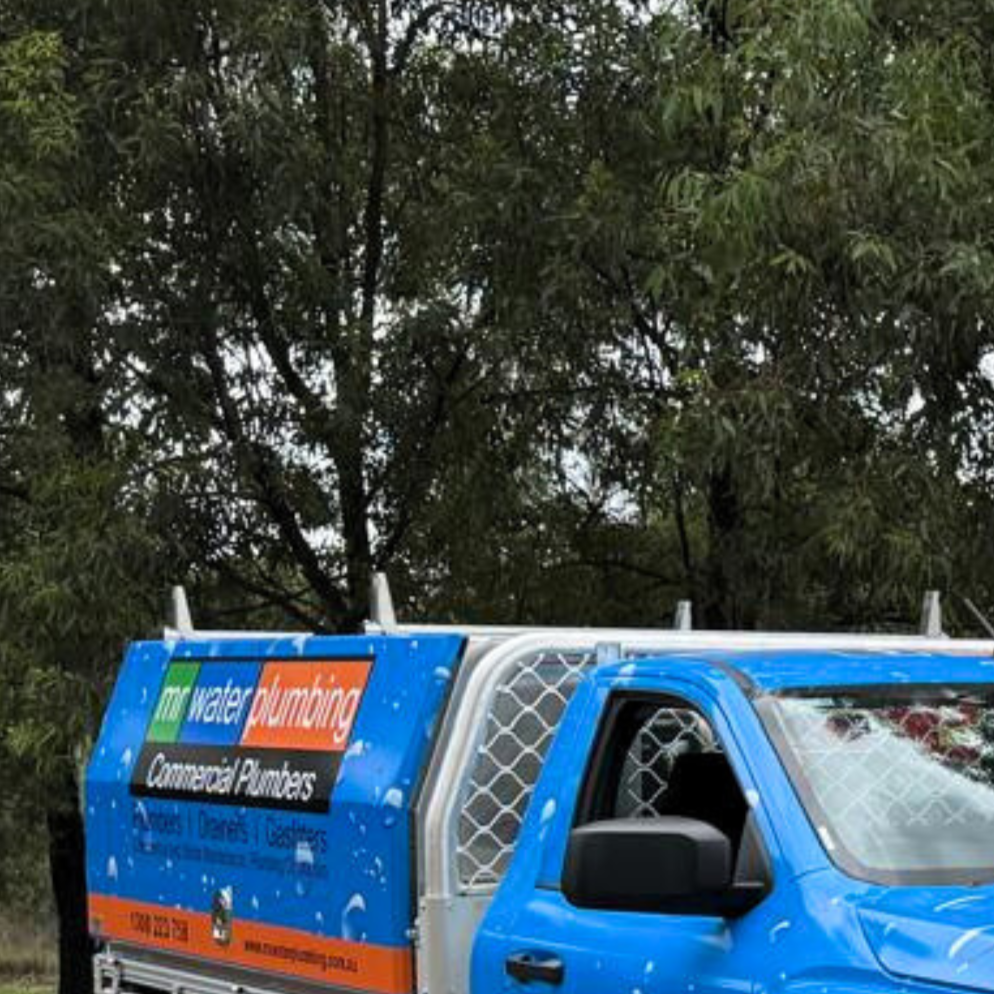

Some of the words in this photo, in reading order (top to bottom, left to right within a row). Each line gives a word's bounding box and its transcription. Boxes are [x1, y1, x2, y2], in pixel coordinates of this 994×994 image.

[153, 685, 191, 723] mr
[188, 678, 253, 725] water
[243, 674, 363, 743] plumbing
[145, 752, 241, 795] Commercial
[234, 758, 317, 801] Plumbers
